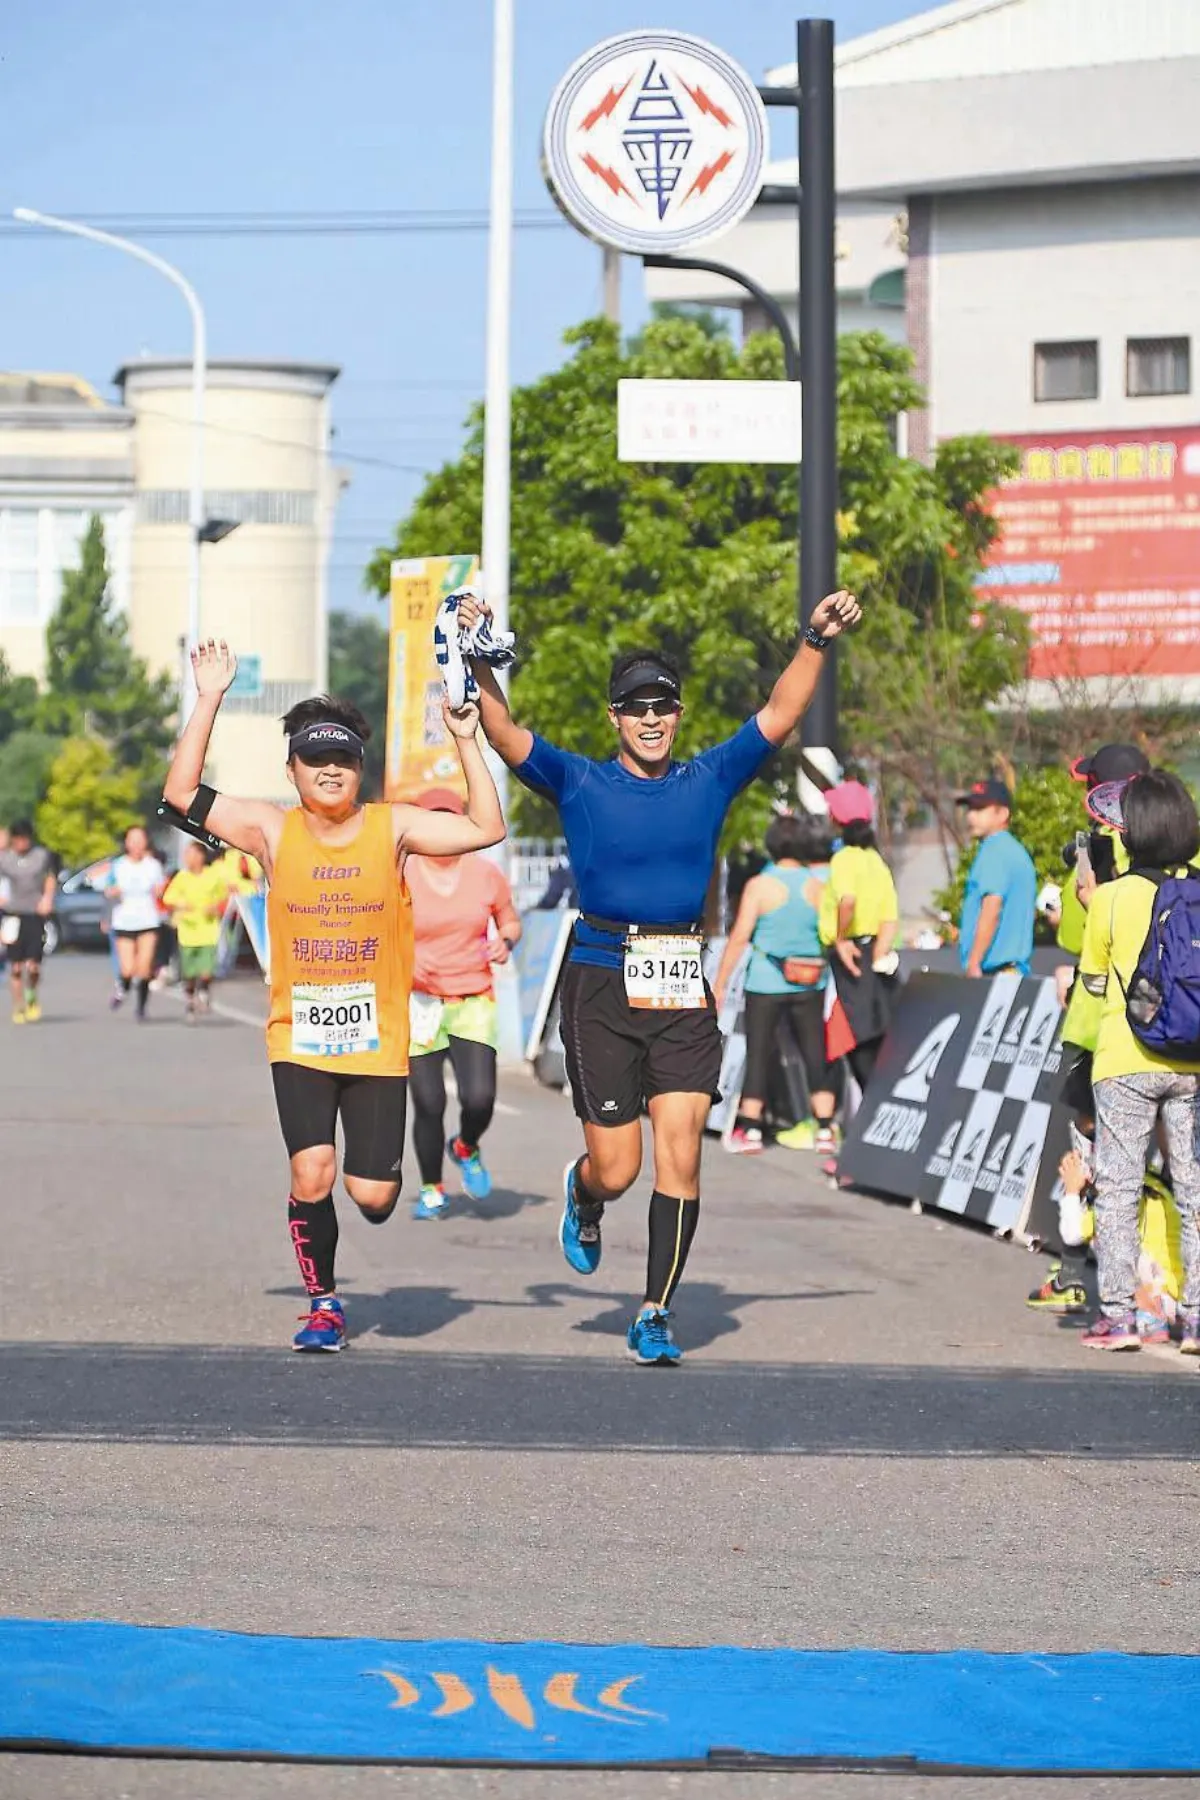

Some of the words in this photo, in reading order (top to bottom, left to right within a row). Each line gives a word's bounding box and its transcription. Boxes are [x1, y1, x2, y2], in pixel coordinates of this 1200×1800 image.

[312, 866, 361, 880] titan
[319, 892, 354, 903] R.O.C.
[286, 901, 332, 916] Visually
[336, 900, 385, 915] Impaired
[292, 936, 380, 963] 視障跑者
